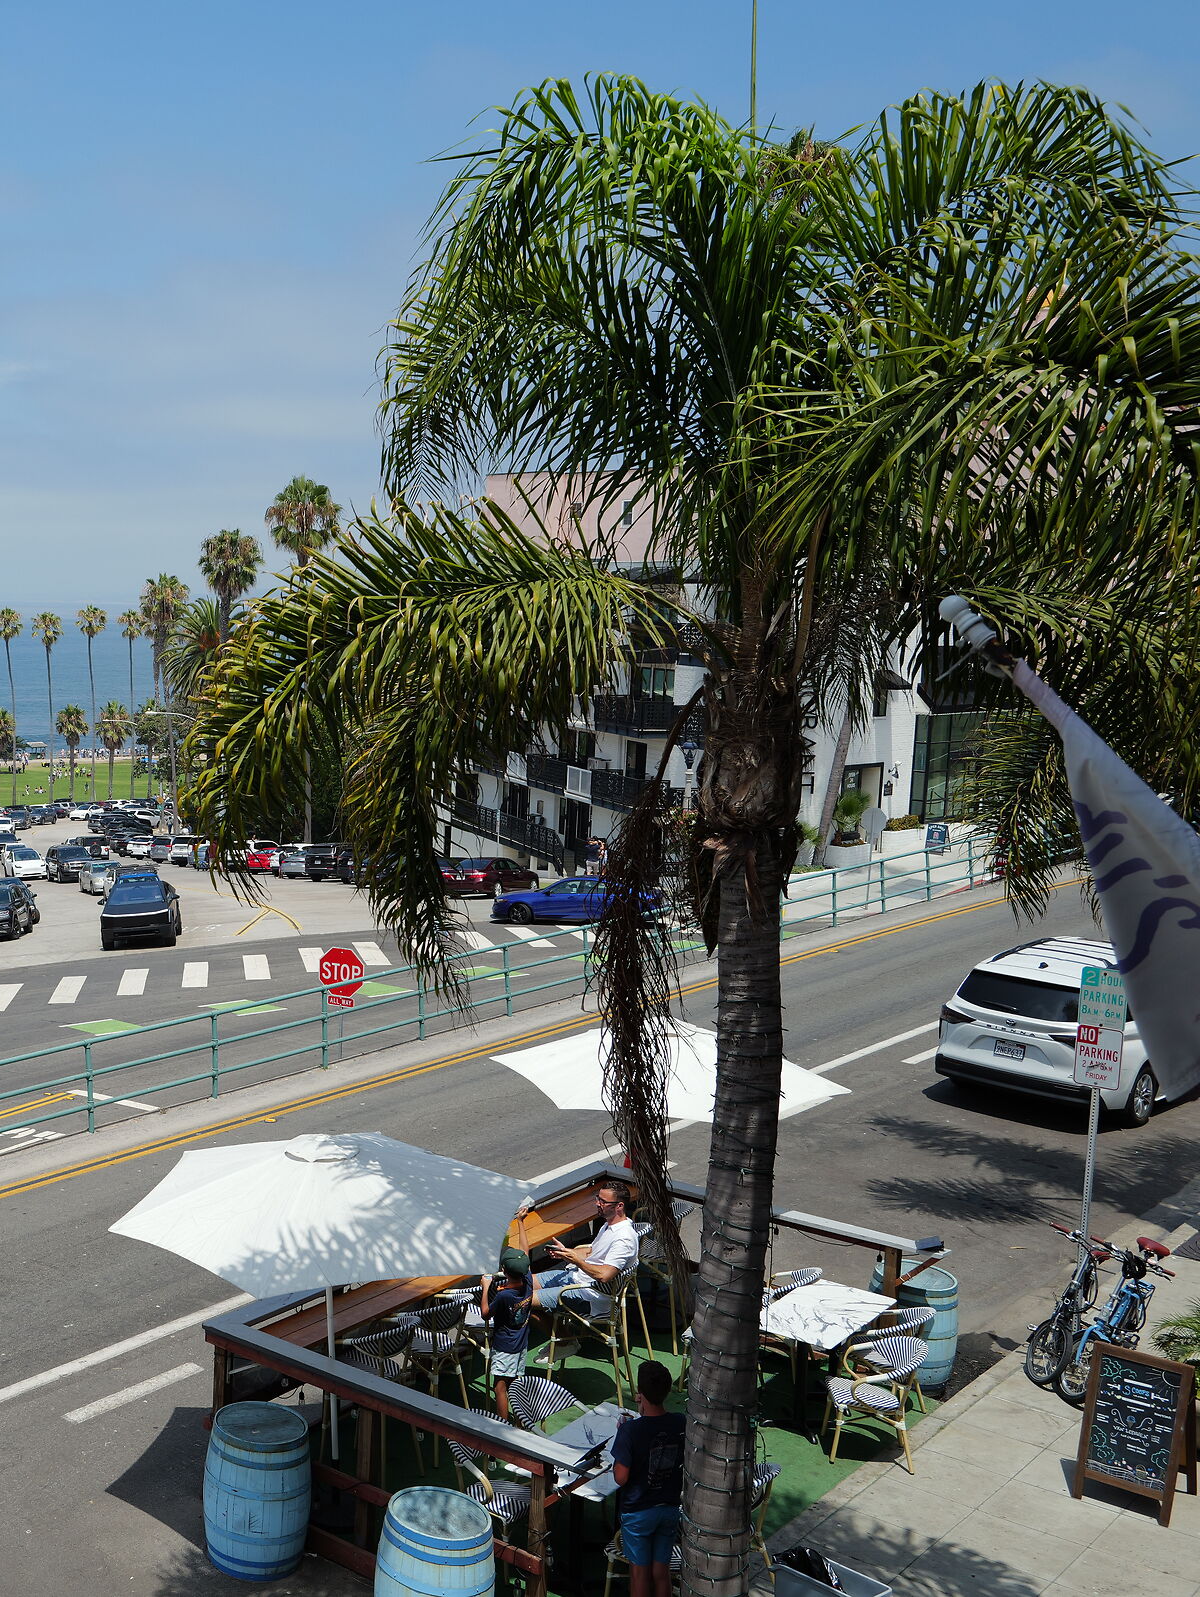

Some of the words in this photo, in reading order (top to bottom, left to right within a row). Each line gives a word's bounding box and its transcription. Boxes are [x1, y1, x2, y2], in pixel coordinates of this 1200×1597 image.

[322, 961, 361, 982] STOP
[1086, 970, 1097, 984] 2
[329, 997, 340, 1005] ALL
[1083, 989, 1124, 1006] PARKING
[1080, 1027, 1097, 1042] NO
[1079, 1045, 1119, 1063] PARKING
[1085, 1071, 1108, 1081] FRIDAY
